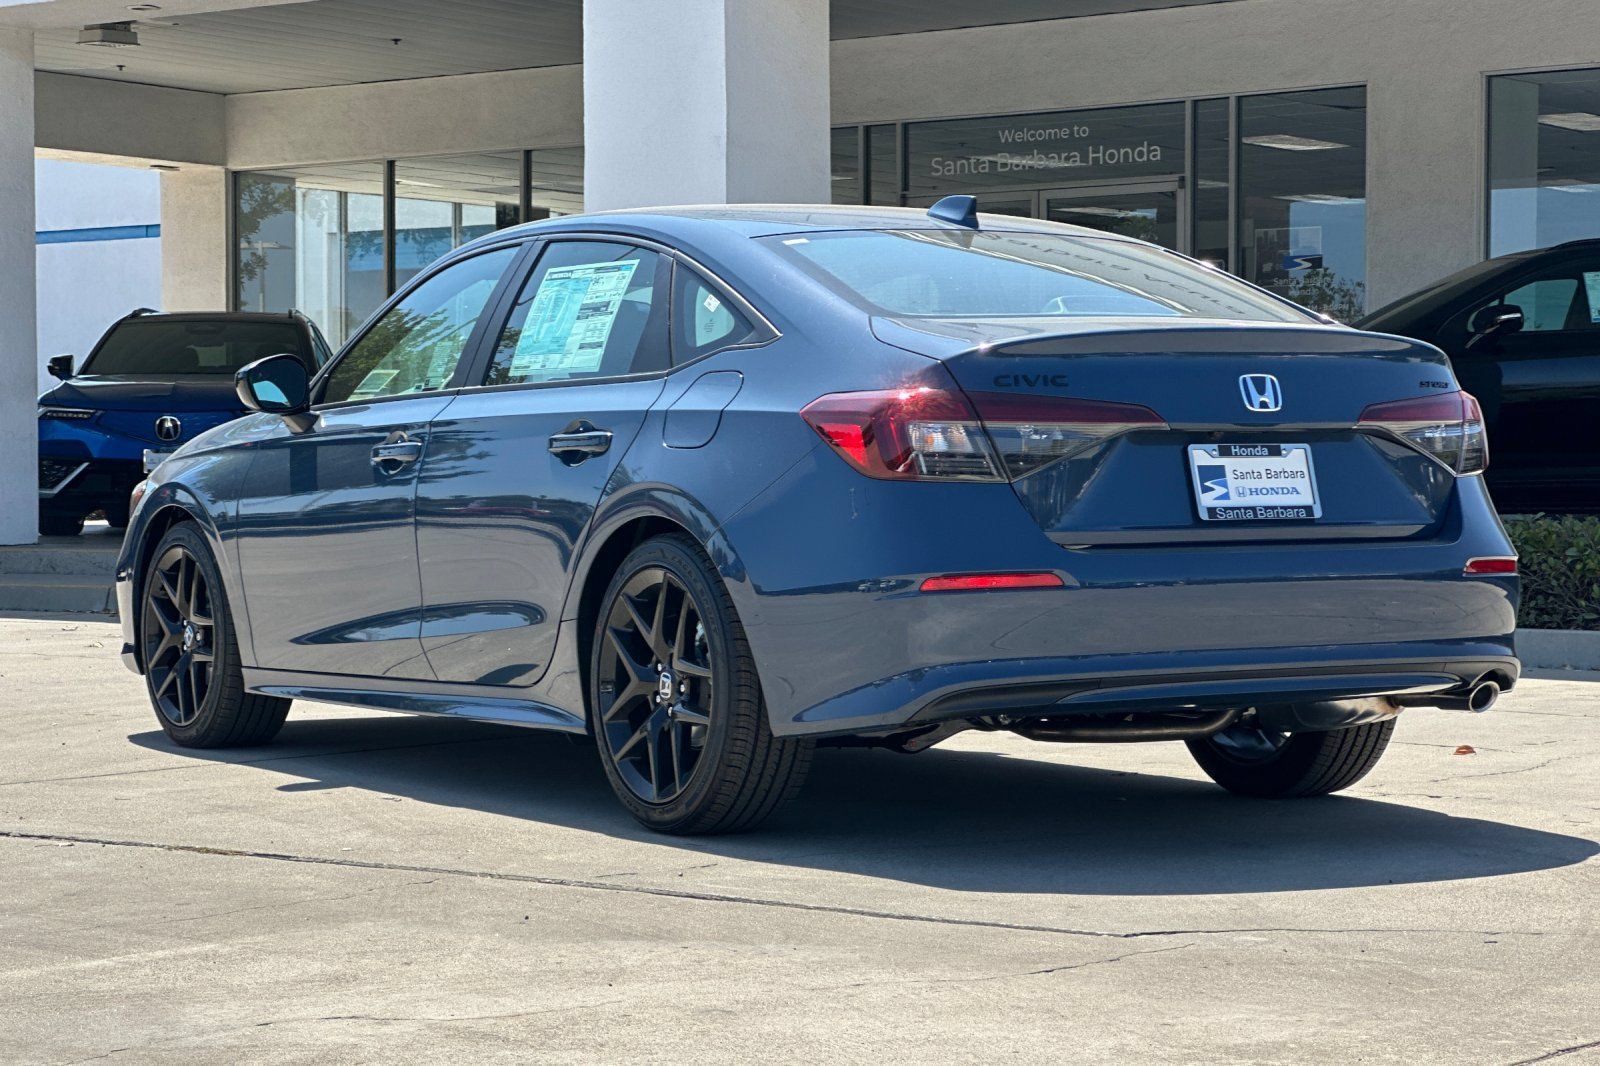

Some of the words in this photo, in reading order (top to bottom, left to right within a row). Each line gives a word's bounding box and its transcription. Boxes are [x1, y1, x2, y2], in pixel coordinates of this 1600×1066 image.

[999, 127, 1069, 144] Welcome
[1073, 124, 1089, 138] to
[930, 156, 989, 177] Santa
[997, 149, 1081, 173] Barbara
[1088, 141, 1162, 166] Honda
[993, 374, 1069, 387] CIVIC
[1231, 445, 1269, 456] Honda
[1232, 469, 1263, 480] Santa
[1265, 468, 1306, 480] Barbara
[1247, 486, 1302, 496] HONDA
[1216, 507, 1252, 519] Santa
[1256, 506, 1307, 519] Barbara
